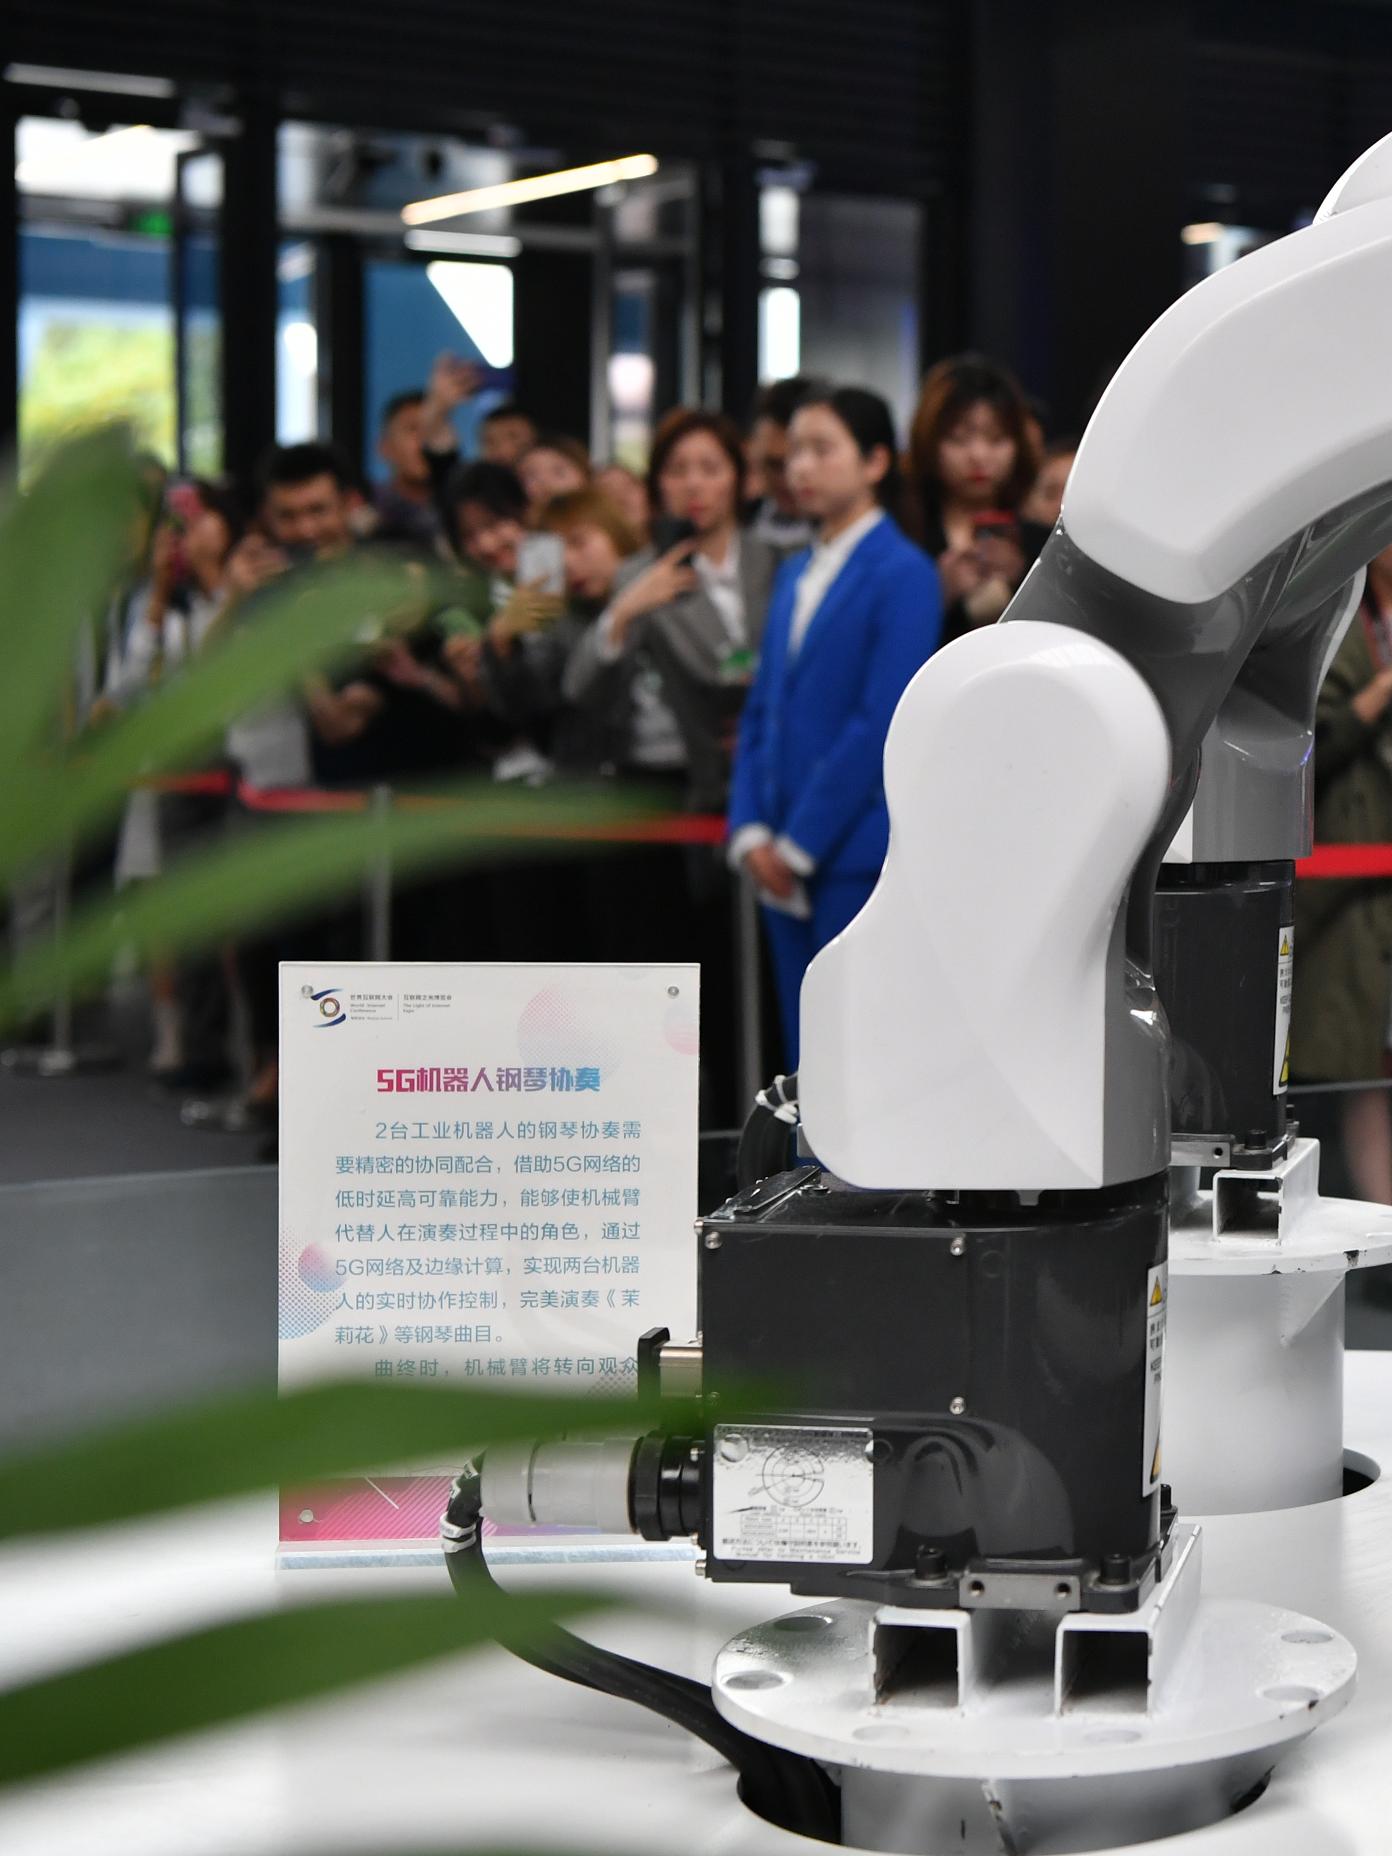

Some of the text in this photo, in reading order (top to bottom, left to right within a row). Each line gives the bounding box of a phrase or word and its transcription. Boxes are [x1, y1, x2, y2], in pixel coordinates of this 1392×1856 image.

[377, 1067, 601, 1092] 5G机器人钢琴协奏
[375, 1120, 641, 1140] 2台工业机器人的钢琴协奏需
